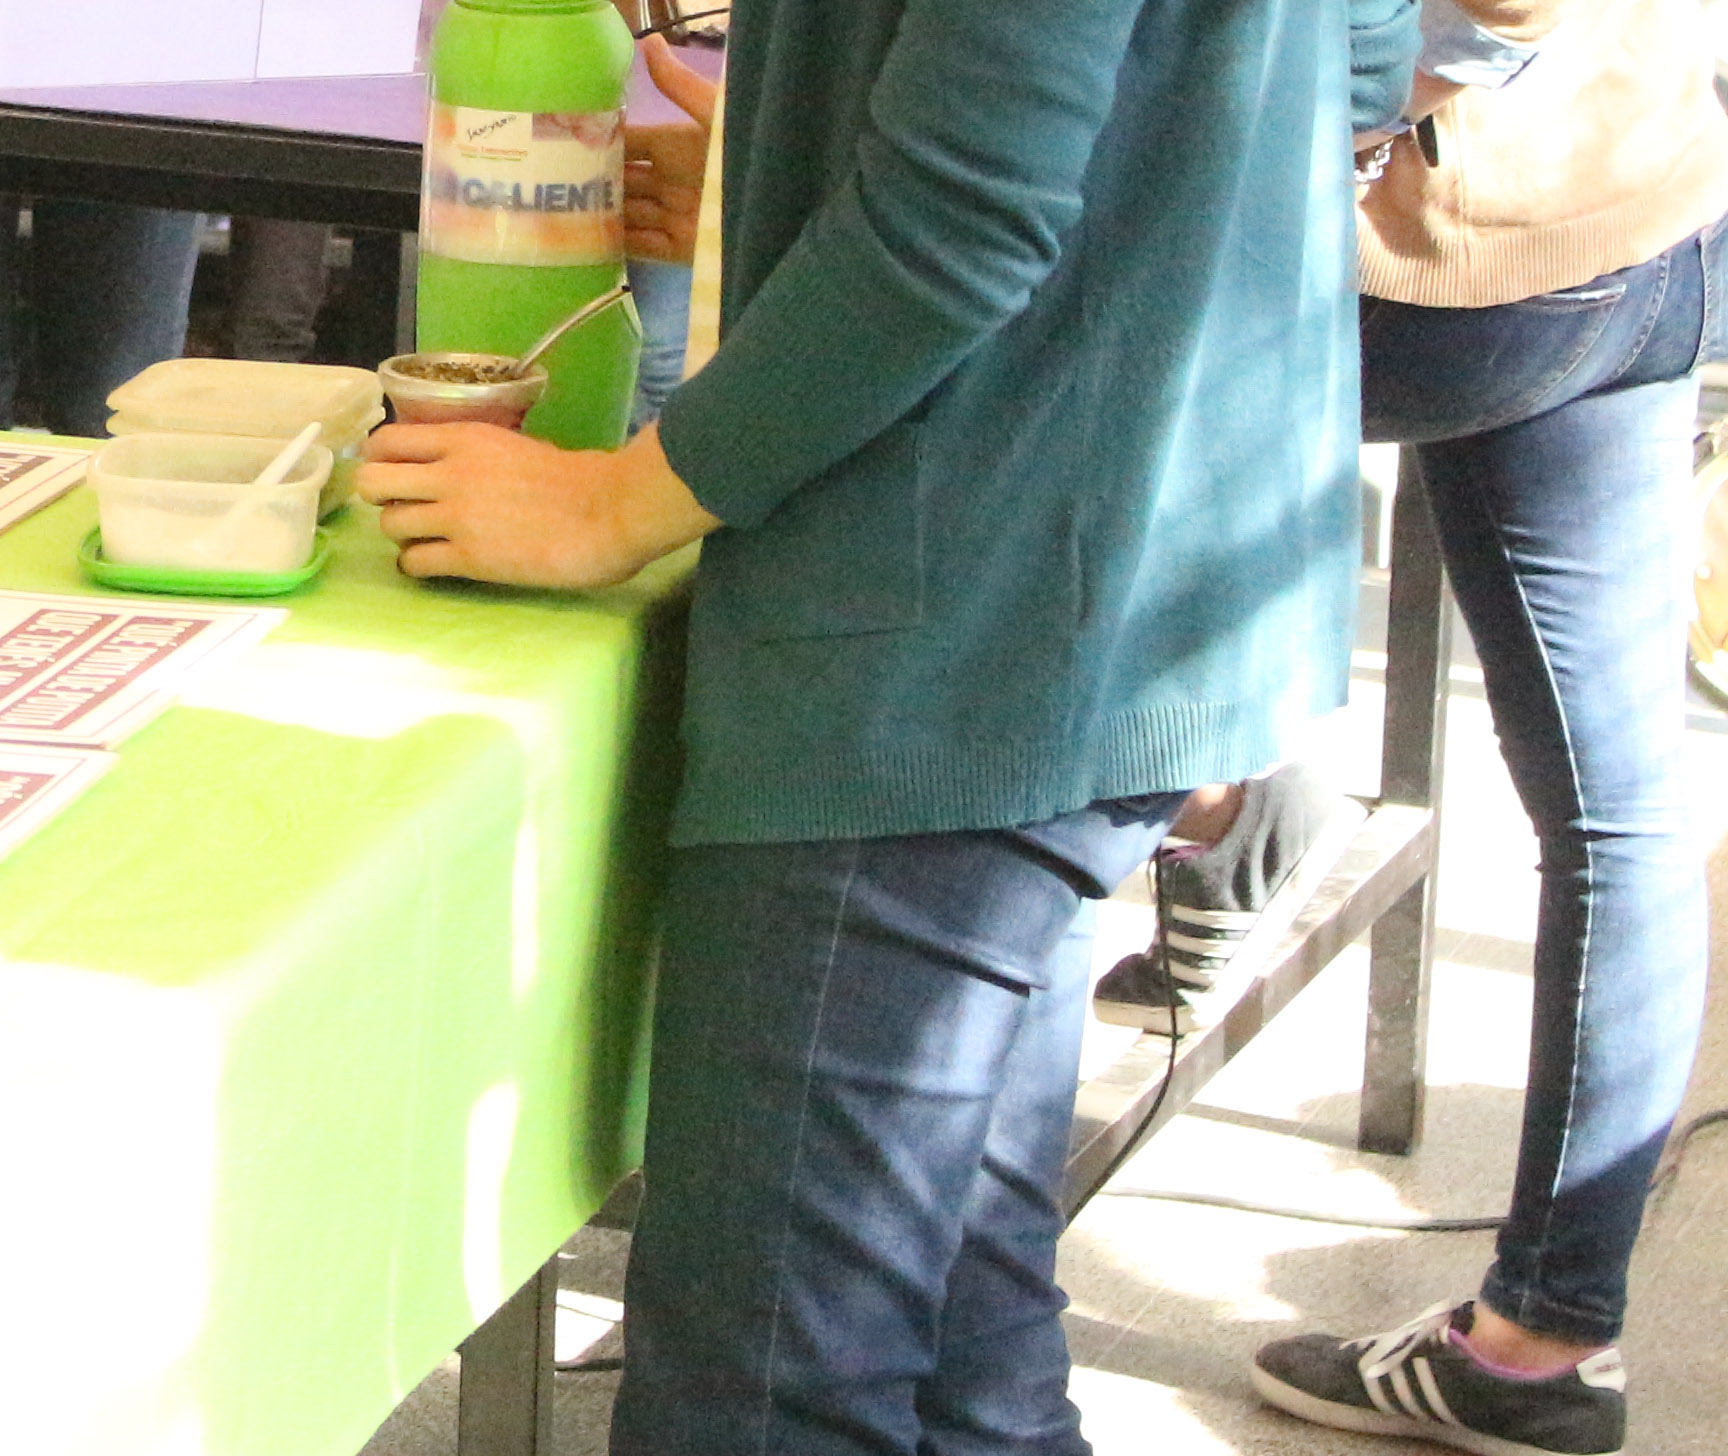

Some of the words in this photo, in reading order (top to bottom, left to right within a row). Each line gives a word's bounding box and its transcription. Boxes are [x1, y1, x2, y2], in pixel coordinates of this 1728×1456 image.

[23, 612, 105, 635] QUE
[64, 645, 159, 676] PINTA
[42, 674, 117, 692] DE
